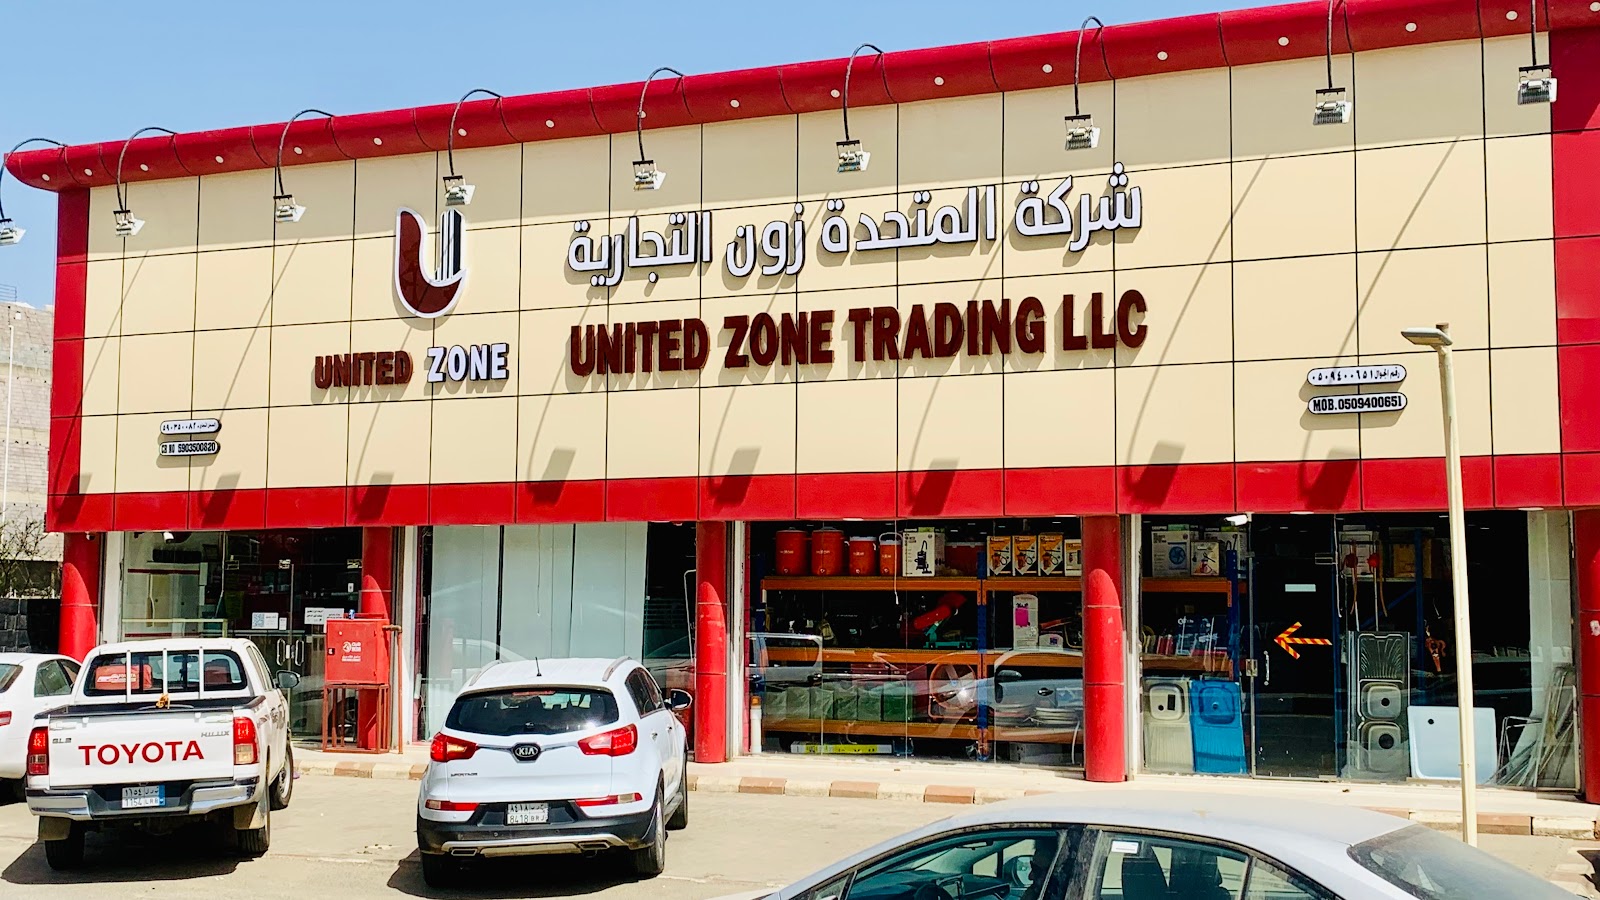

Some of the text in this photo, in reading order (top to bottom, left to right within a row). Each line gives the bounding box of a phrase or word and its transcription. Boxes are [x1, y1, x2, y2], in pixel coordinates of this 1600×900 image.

[567, 162, 1142, 287] شركة المتحدة زون التجارية
[570, 289, 1148, 377] UNITED ZONE TRADING LLC
[314, 343, 509, 389] UNITED ZONE
[1312, 369, 1373, 381] ٠٥٠٩٤٠٠٦٥١
[78, 740, 204, 766] TOYOTA
[518, 747, 535, 756] KIA
[509, 814, 529, 823] 8418
